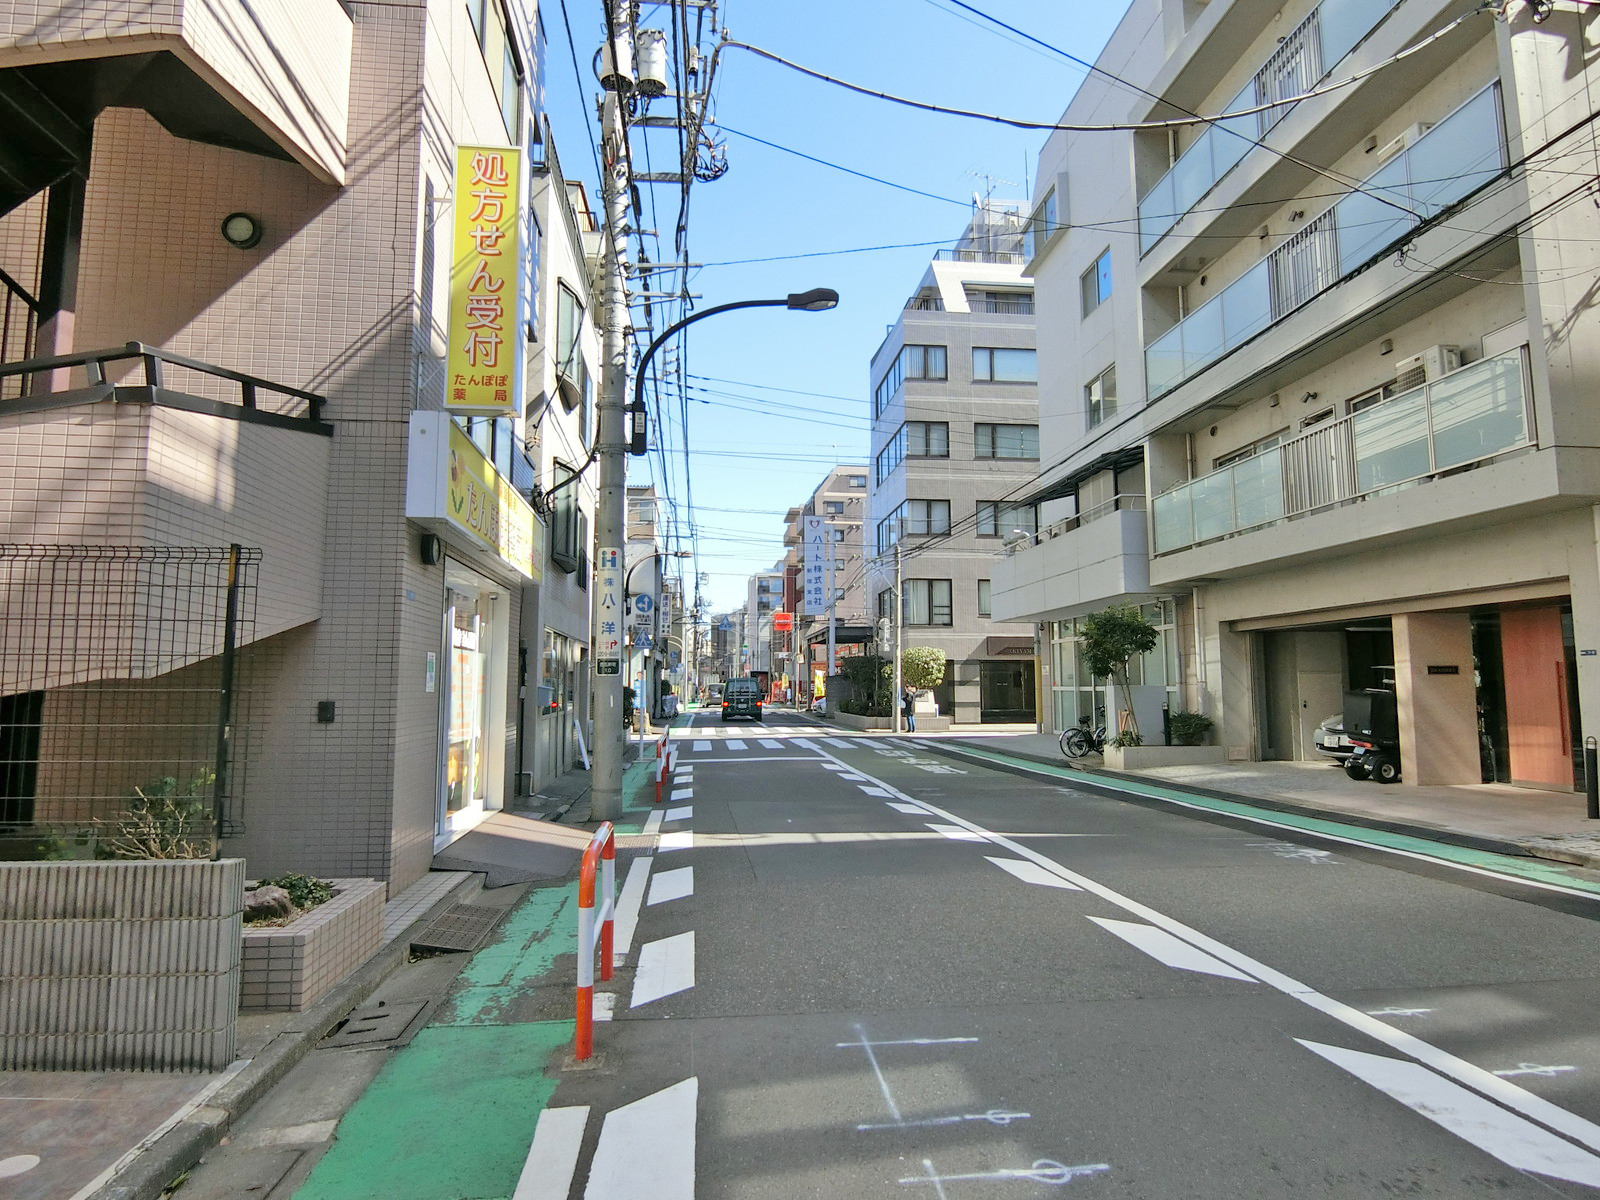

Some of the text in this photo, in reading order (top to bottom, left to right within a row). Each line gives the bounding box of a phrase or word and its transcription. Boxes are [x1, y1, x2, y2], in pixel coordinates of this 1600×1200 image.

[463, 151, 509, 368] 処方せん受付
[453, 388, 507, 402] 薬局
[454, 374, 508, 387] たんぽぽ
[813, 536, 823, 606] ハート株式会社
